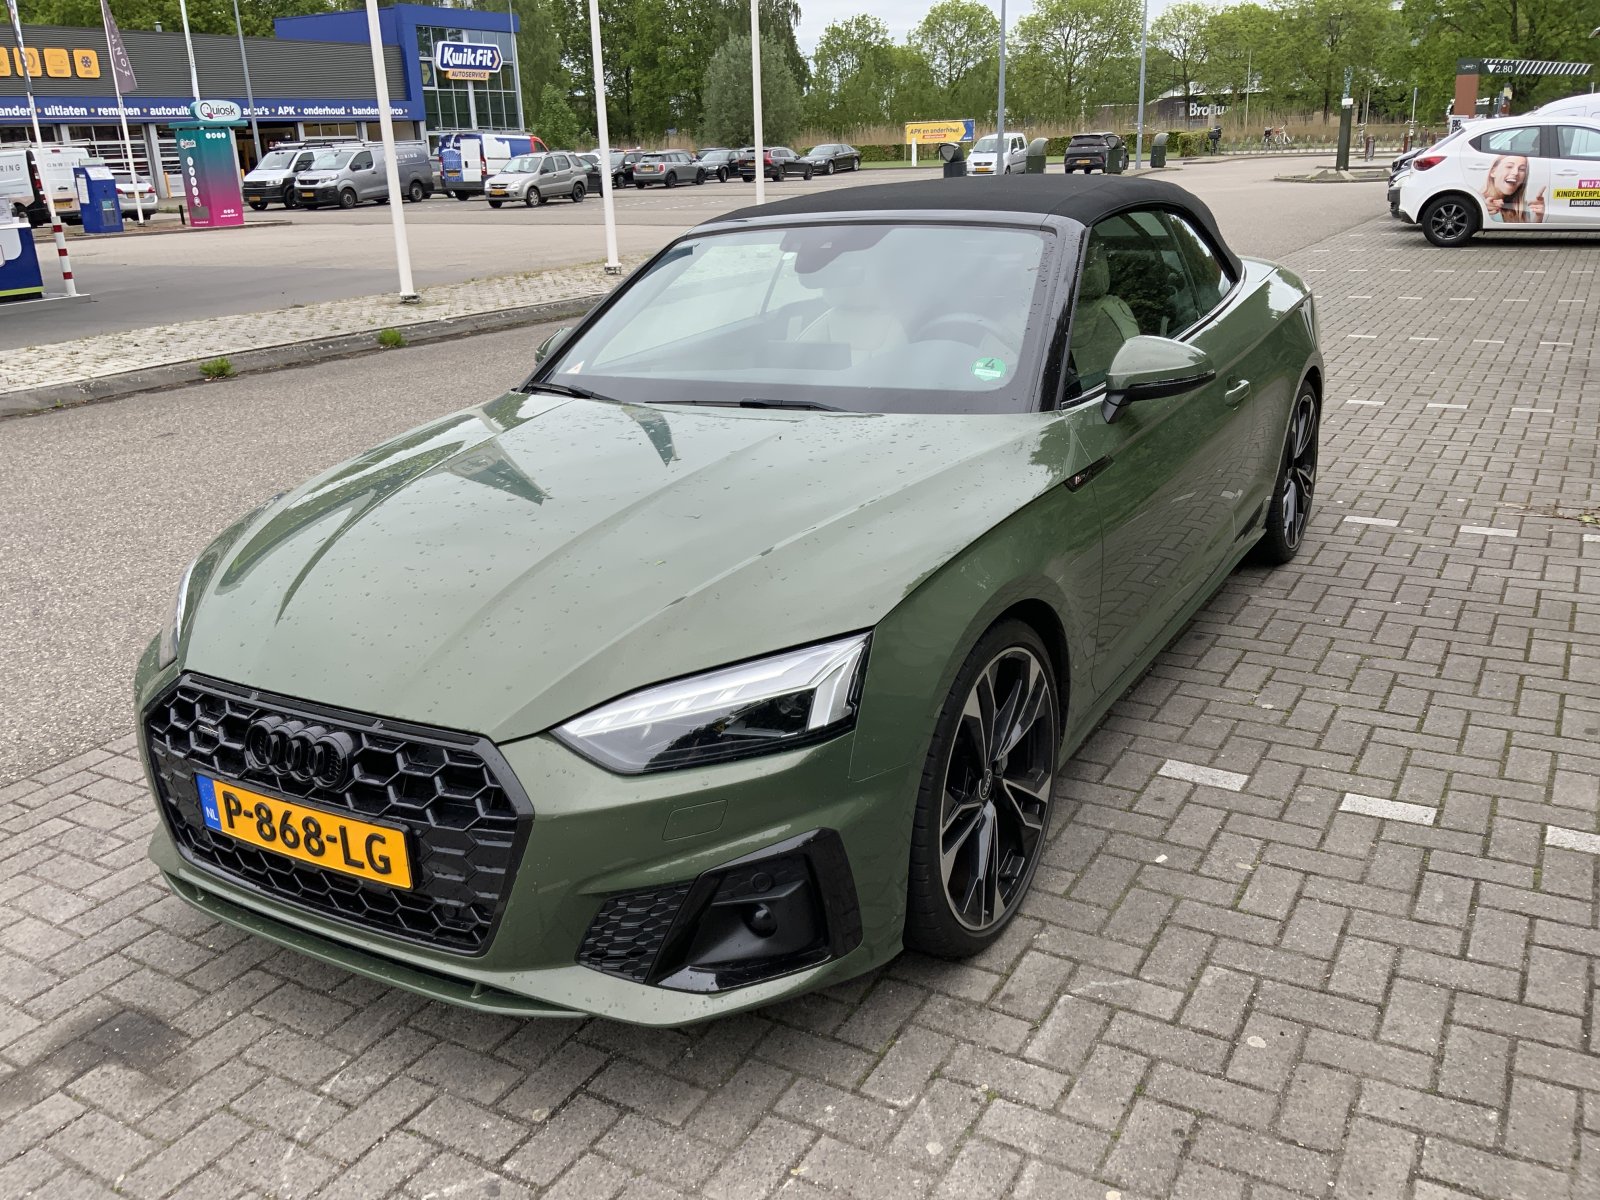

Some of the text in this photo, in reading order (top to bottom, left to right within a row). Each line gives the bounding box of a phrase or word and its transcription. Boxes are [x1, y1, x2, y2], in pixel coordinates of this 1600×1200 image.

[443, 46, 493, 67] KwikFit
[451, 70, 487, 79] AUTOSERVICE
[1495, 65, 1513, 73] 2.80
[44, 105, 88, 116] uitlaten
[277, 106, 296, 115] APK
[303, 106, 346, 116] onderhoud
[352, 106, 379, 116] banden
[200, 102, 236, 119] Quiosk
[1581, 180, 1594, 188] WIJ
[984, 358, 995, 369] 4
[206, 790, 393, 875] NL P-868-LG
